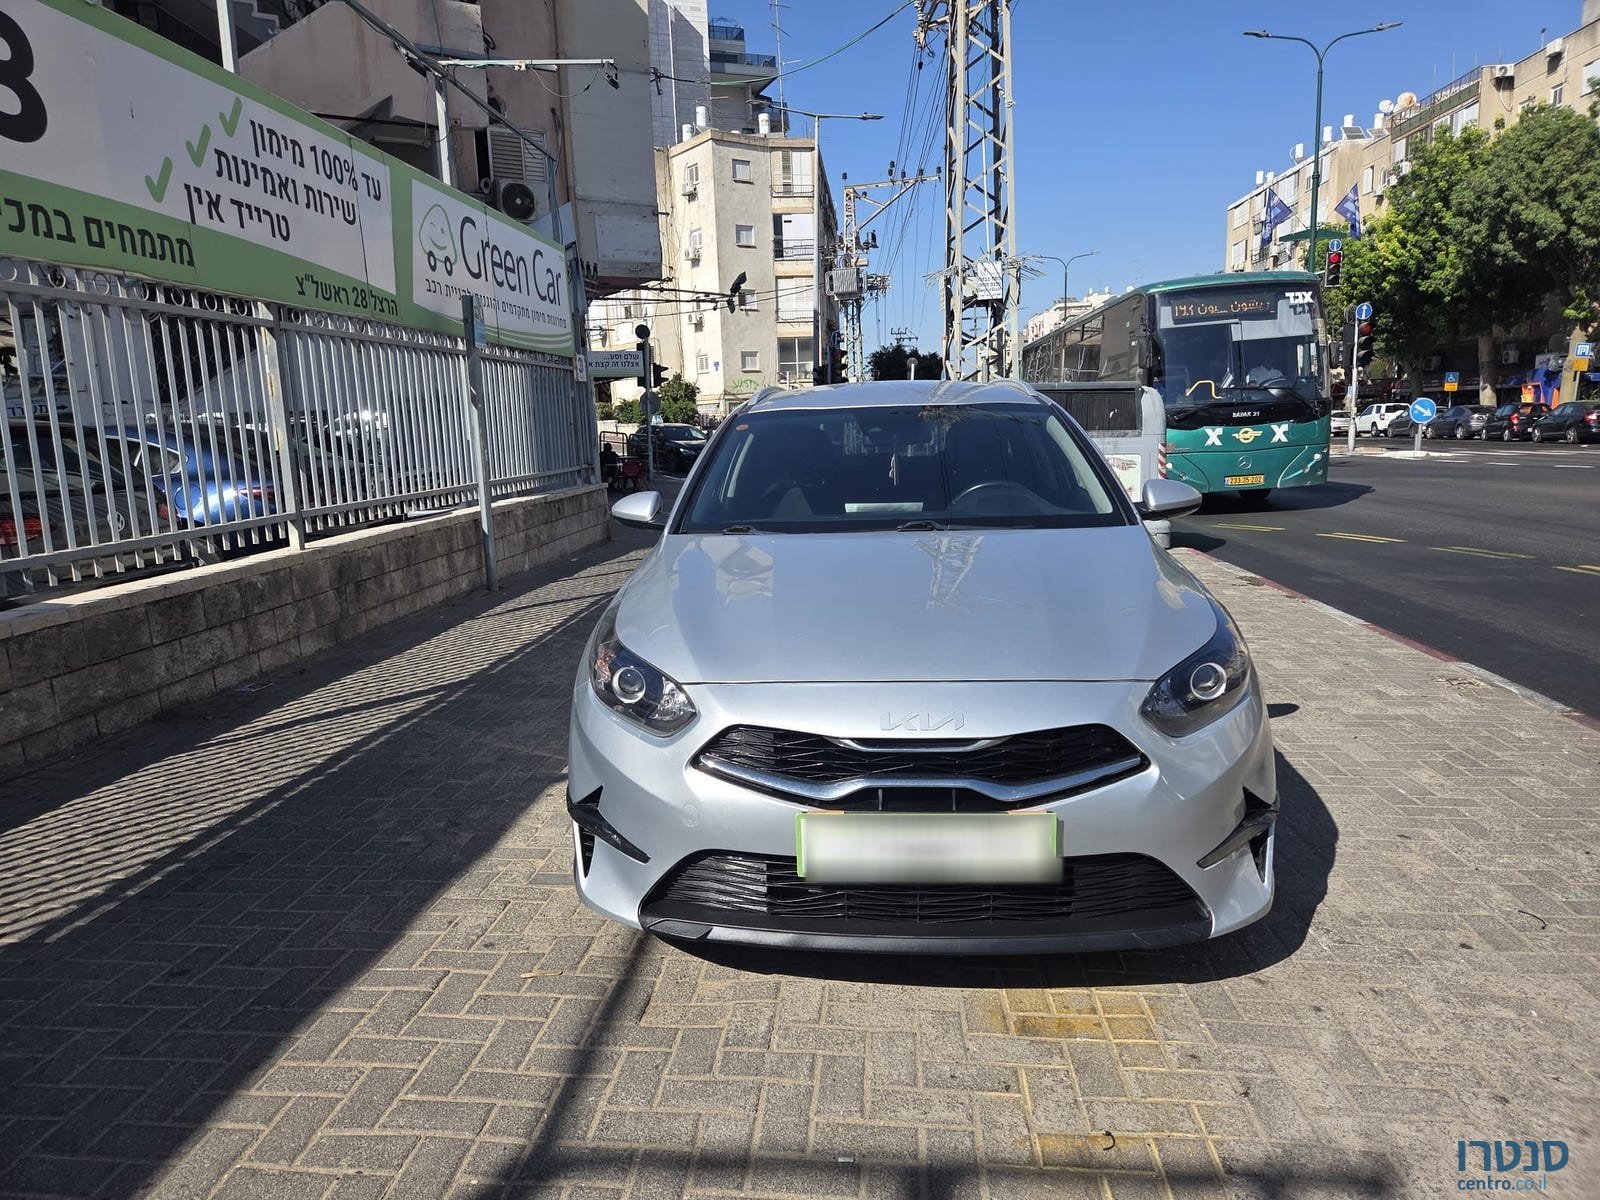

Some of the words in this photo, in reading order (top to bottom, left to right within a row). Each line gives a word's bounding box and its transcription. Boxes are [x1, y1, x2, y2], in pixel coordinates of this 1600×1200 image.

[250, 120, 305, 168] מימון
[215, 148, 299, 204] ואמינות
[310, 145, 358, 192] 100%
[361, 172, 382, 201] עד
[0, 198, 76, 243] במכ
[184, 183, 224, 225] אין
[230, 198, 291, 242] טרייד
[304, 184, 357, 226] שירות
[84, 216, 195, 267] מתמחים
[460, 216, 530, 297] Green
[532, 249, 562, 306] Car
[352, 286, 369, 308] 28
[370, 289, 399, 317] הרצל
[425, 278, 443, 296] רכב
[474, 292, 500, 311] והוגני
[624, 353, 640, 361] שלם
